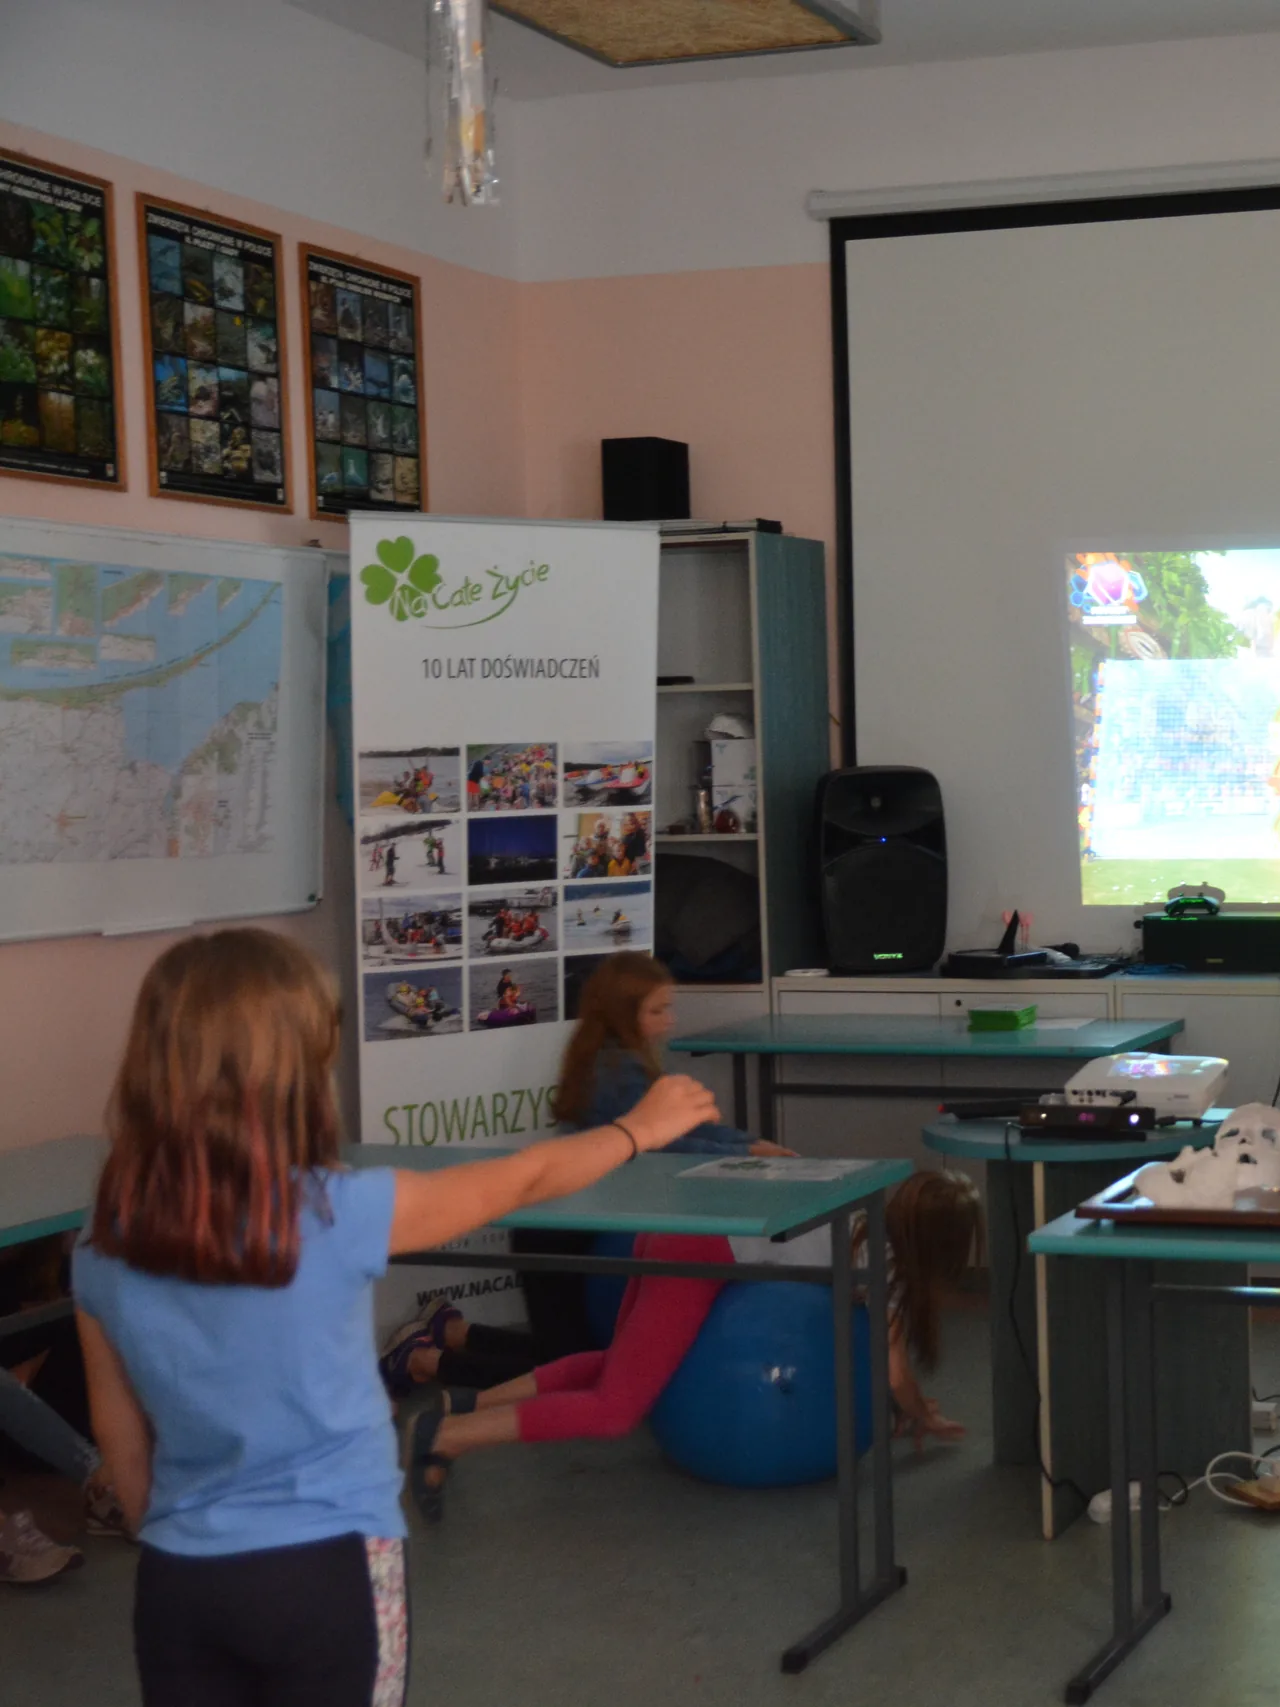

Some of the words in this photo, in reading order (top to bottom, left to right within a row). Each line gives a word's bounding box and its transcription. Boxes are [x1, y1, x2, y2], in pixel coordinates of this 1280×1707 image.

[393, 585, 430, 621] Na
[421, 658, 442, 680] 10
[446, 658, 477, 679] LAT
[481, 654, 601, 680] DOŚWIADCZEŃ
